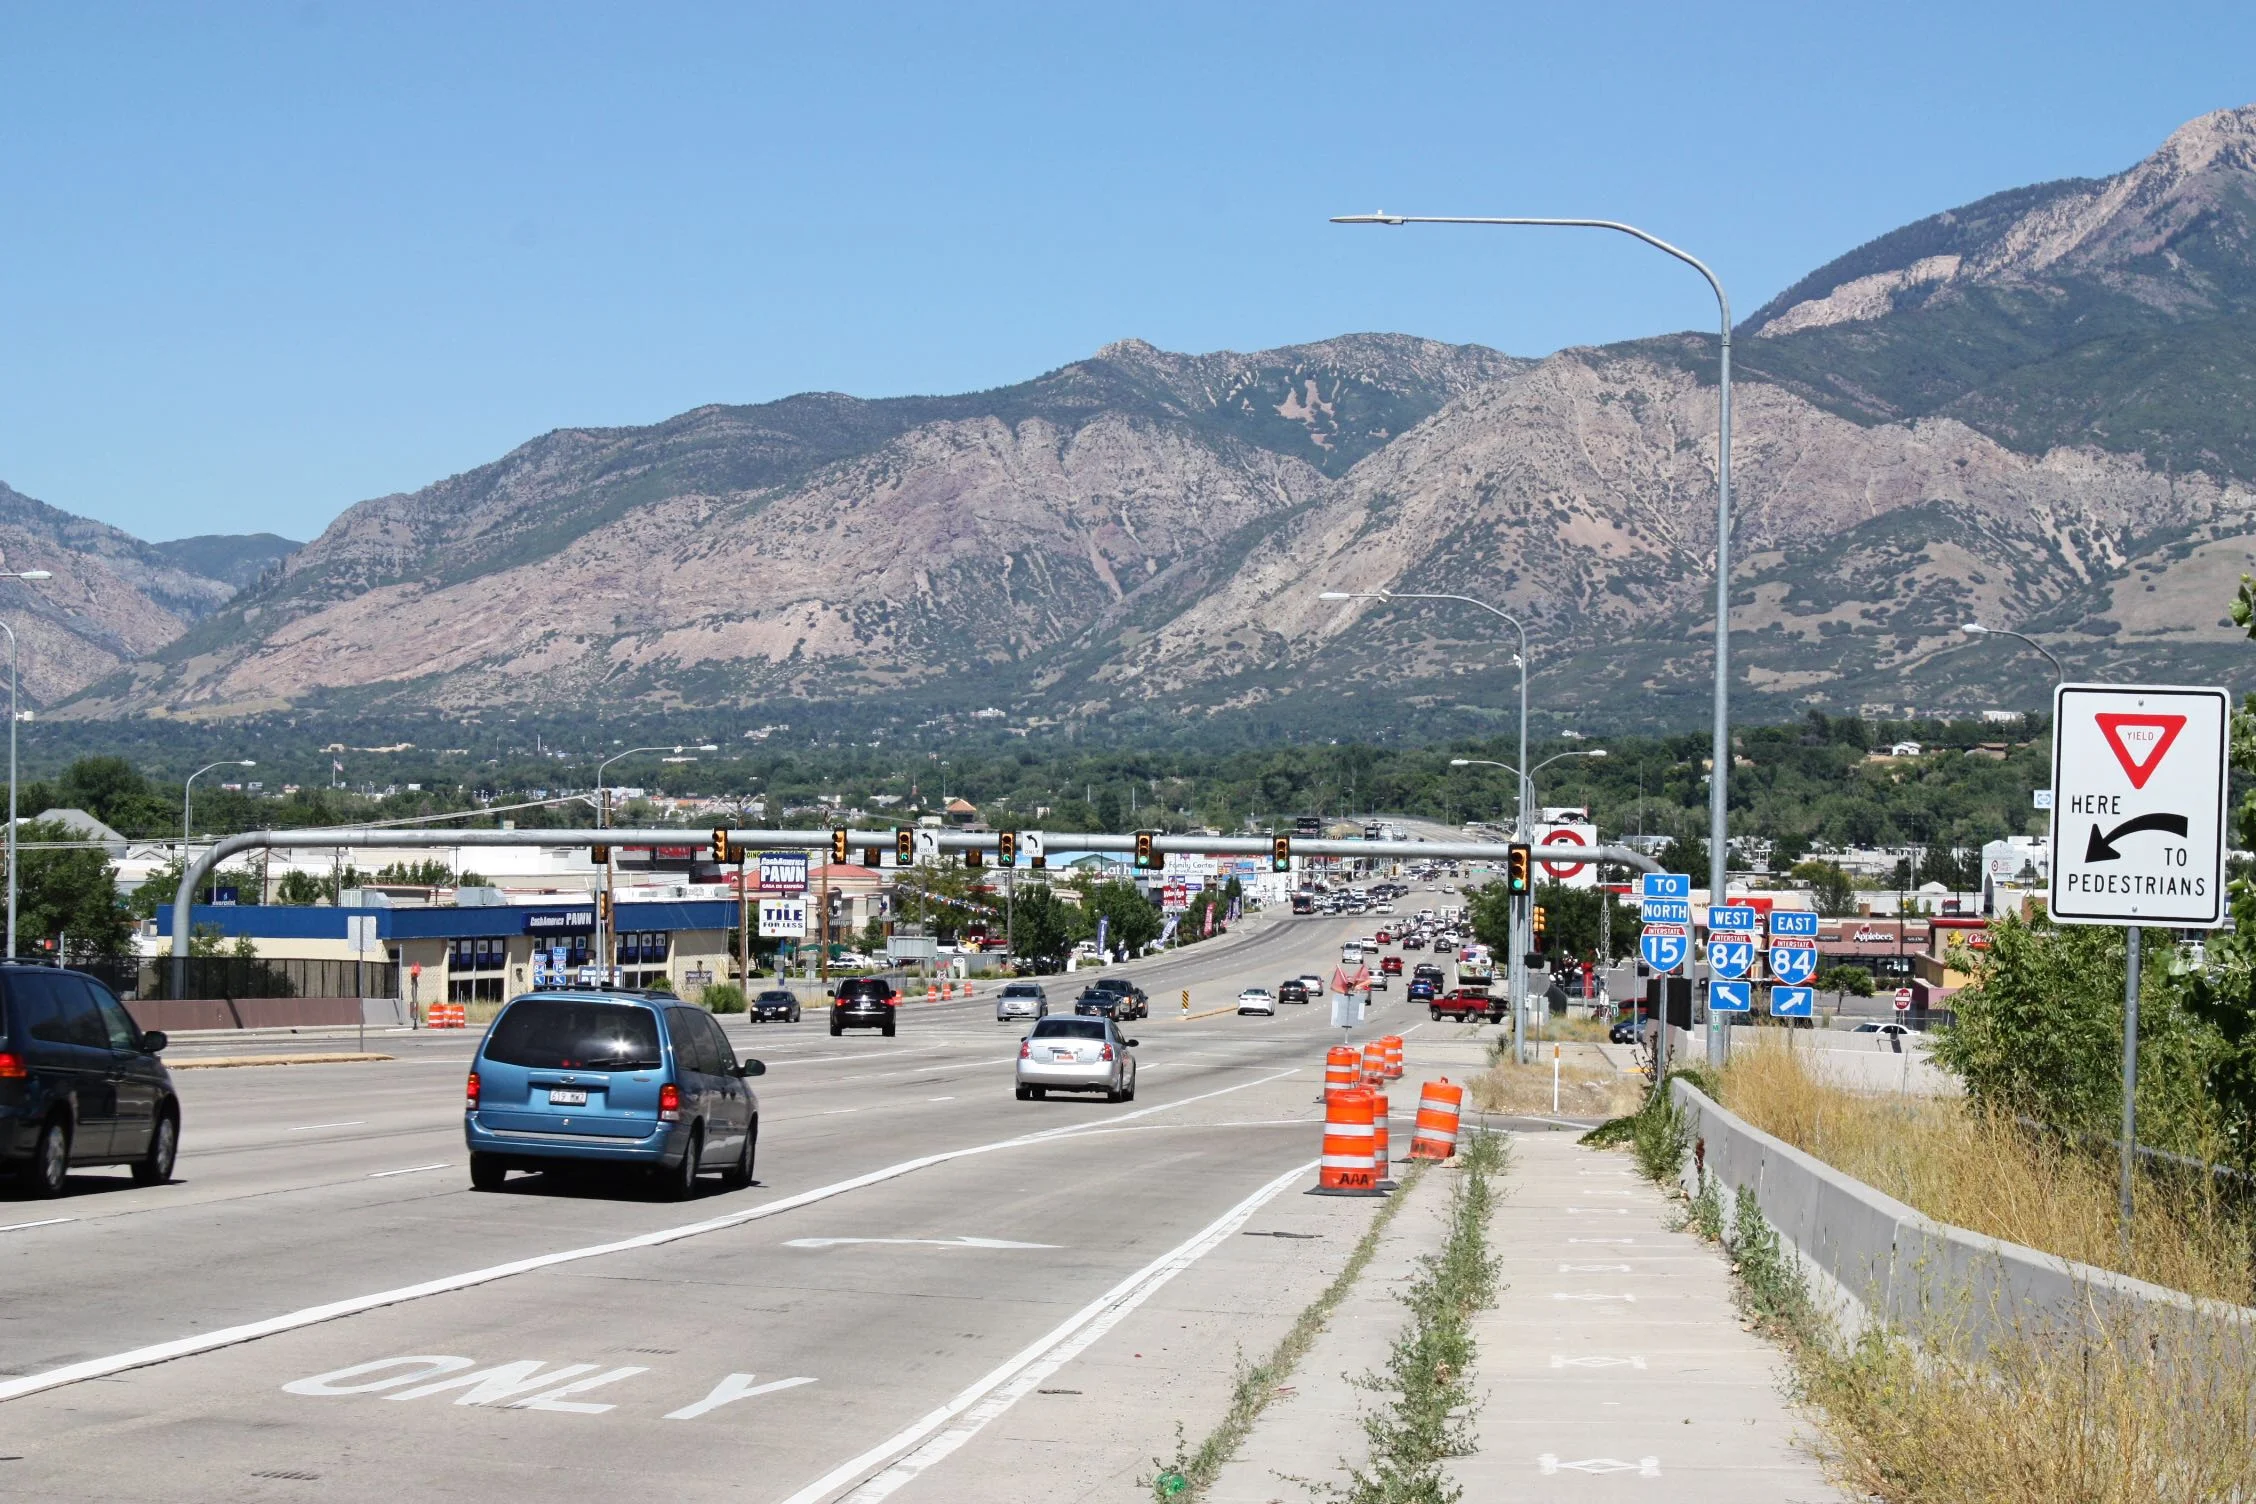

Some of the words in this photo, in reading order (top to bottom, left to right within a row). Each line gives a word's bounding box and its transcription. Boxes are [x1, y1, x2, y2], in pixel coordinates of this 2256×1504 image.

[2127, 731, 2154, 741] YIELD
[2071, 795, 2121, 815] HERE
[2164, 848, 2187, 867] TO
[760, 866, 806, 882] PAWN
[1108, 863, 1121, 875] at
[1655, 879, 1677, 893] TO
[2068, 874, 2205, 897] PEDESTRIANS
[566, 912, 592, 925] PAWN
[764, 908, 803, 921] TILE
[1644, 904, 1687, 919] NORTH
[1714, 912, 1748, 926] WEST
[1777, 917, 1811, 931] EAST
[1648, 927, 1681, 935] INTERSTATE
[1714, 934, 1747, 942] INTERSTATE
[1853, 930, 1894, 942] Applebee's
[1650, 937, 1678, 964] 15
[1777, 940, 1810, 948] INTERSTATE
[1711, 943, 1748, 969] 84
[1773, 949, 1811, 975] 84
[534, 965, 545, 973] 84
[555, 964, 564, 972] 15
[1338, 1173, 1369, 1185] AAA
[282, 1355, 820, 1419] ONLY
